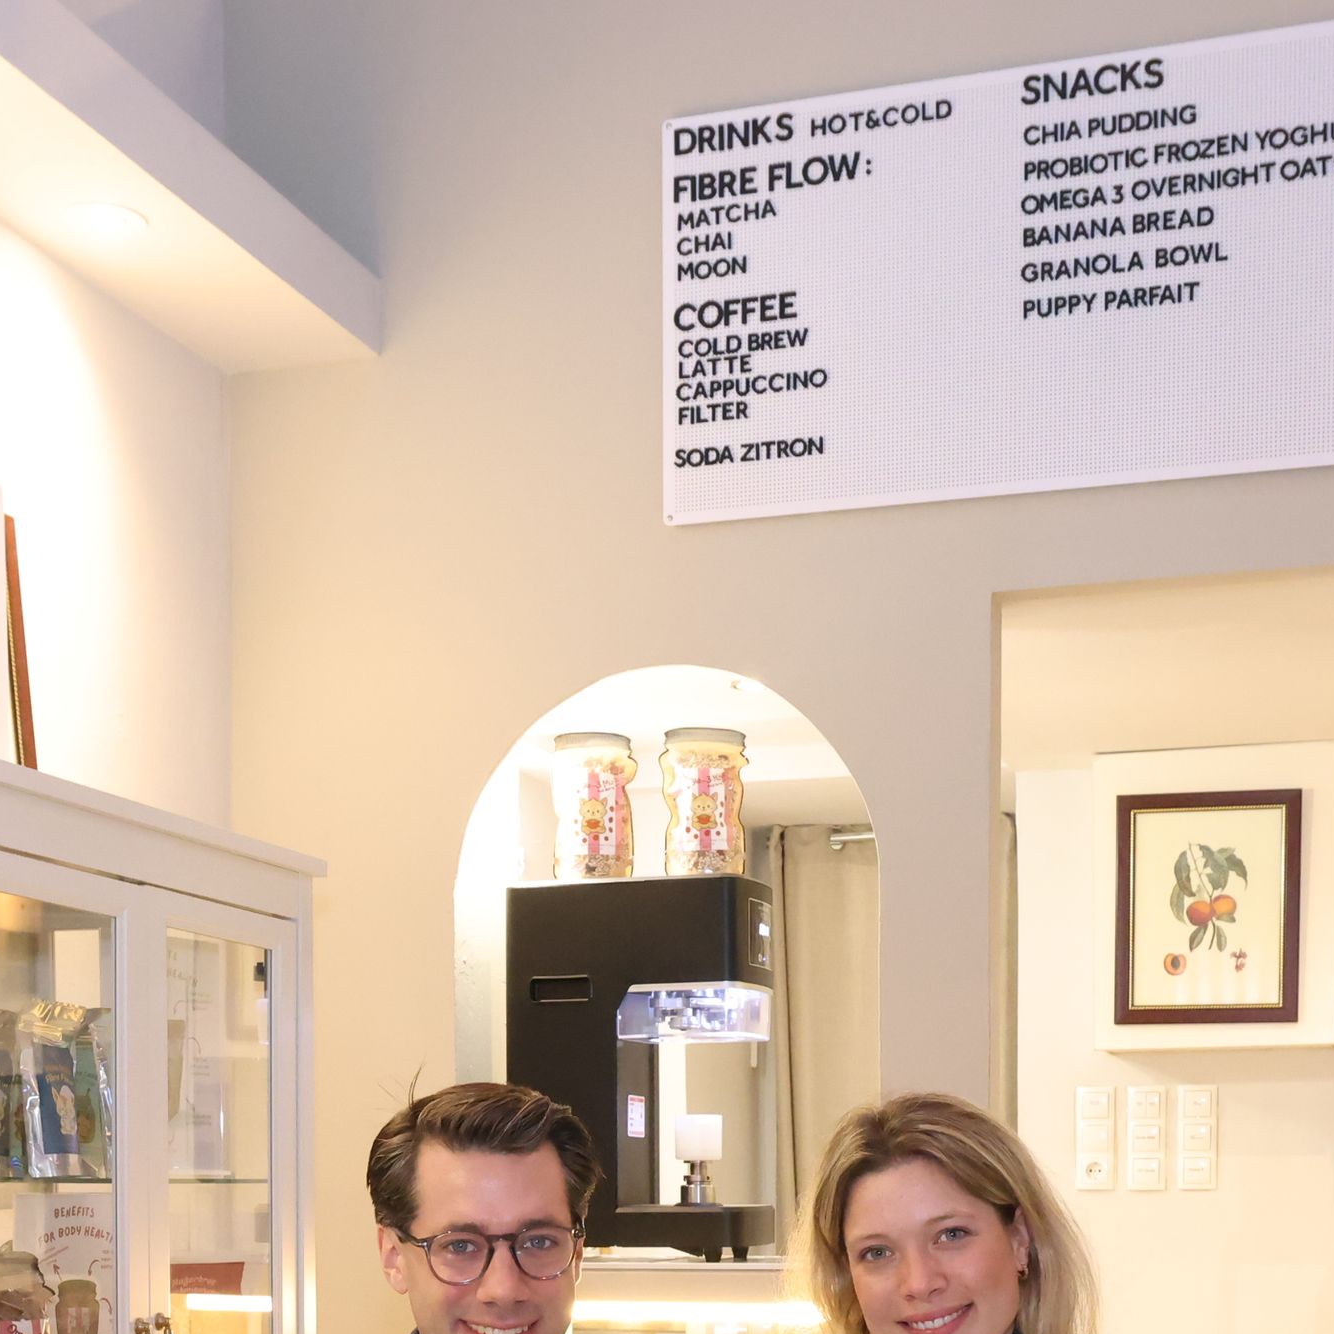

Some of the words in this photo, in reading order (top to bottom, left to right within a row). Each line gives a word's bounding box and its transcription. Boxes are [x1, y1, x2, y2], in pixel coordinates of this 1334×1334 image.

[1021, 58, 1164, 105] SNACKS
[674, 113, 794, 156] DRINKS
[810, 100, 952, 137] HOT&COLD
[1023, 120, 1082, 146] CHIA
[1088, 104, 1197, 138] PUDDING
[1024, 147, 1149, 181] PROBIOTIC
[1154, 132, 1248, 164] FROZEN
[673, 166, 758, 204] FIBRE
[1020, 186, 1108, 216] OMEGA
[1111, 184, 1124, 205] 3
[1131, 161, 1276, 201] OVERNIGHT
[677, 199, 777, 232] MATCHA
[1023, 216, 1126, 248] BANANA
[1132, 206, 1215, 235] BREAD
[676, 231, 732, 256] CHAI
[677, 255, 747, 282] MOON
[1020, 251, 1144, 283] GRANOLA
[1155, 242, 1228, 269] BOWL
[673, 291, 798, 332] COFFEE
[1023, 293, 1097, 320] PUPPY
[1104, 281, 1200, 312] PARFAIT
[678, 335, 742, 359] COLD
[747, 327, 809, 352] BREW
[676, 367, 828, 402] CAPPUCCINO
[678, 354, 752, 379] LATTE
[678, 400, 748, 426] FILTER
[674, 445, 734, 468] SODA
[740, 436, 824, 462] ZITRON
[54, 1205, 95, 1219] BENEFITS
[58, 1225, 82, 1239] BODY
